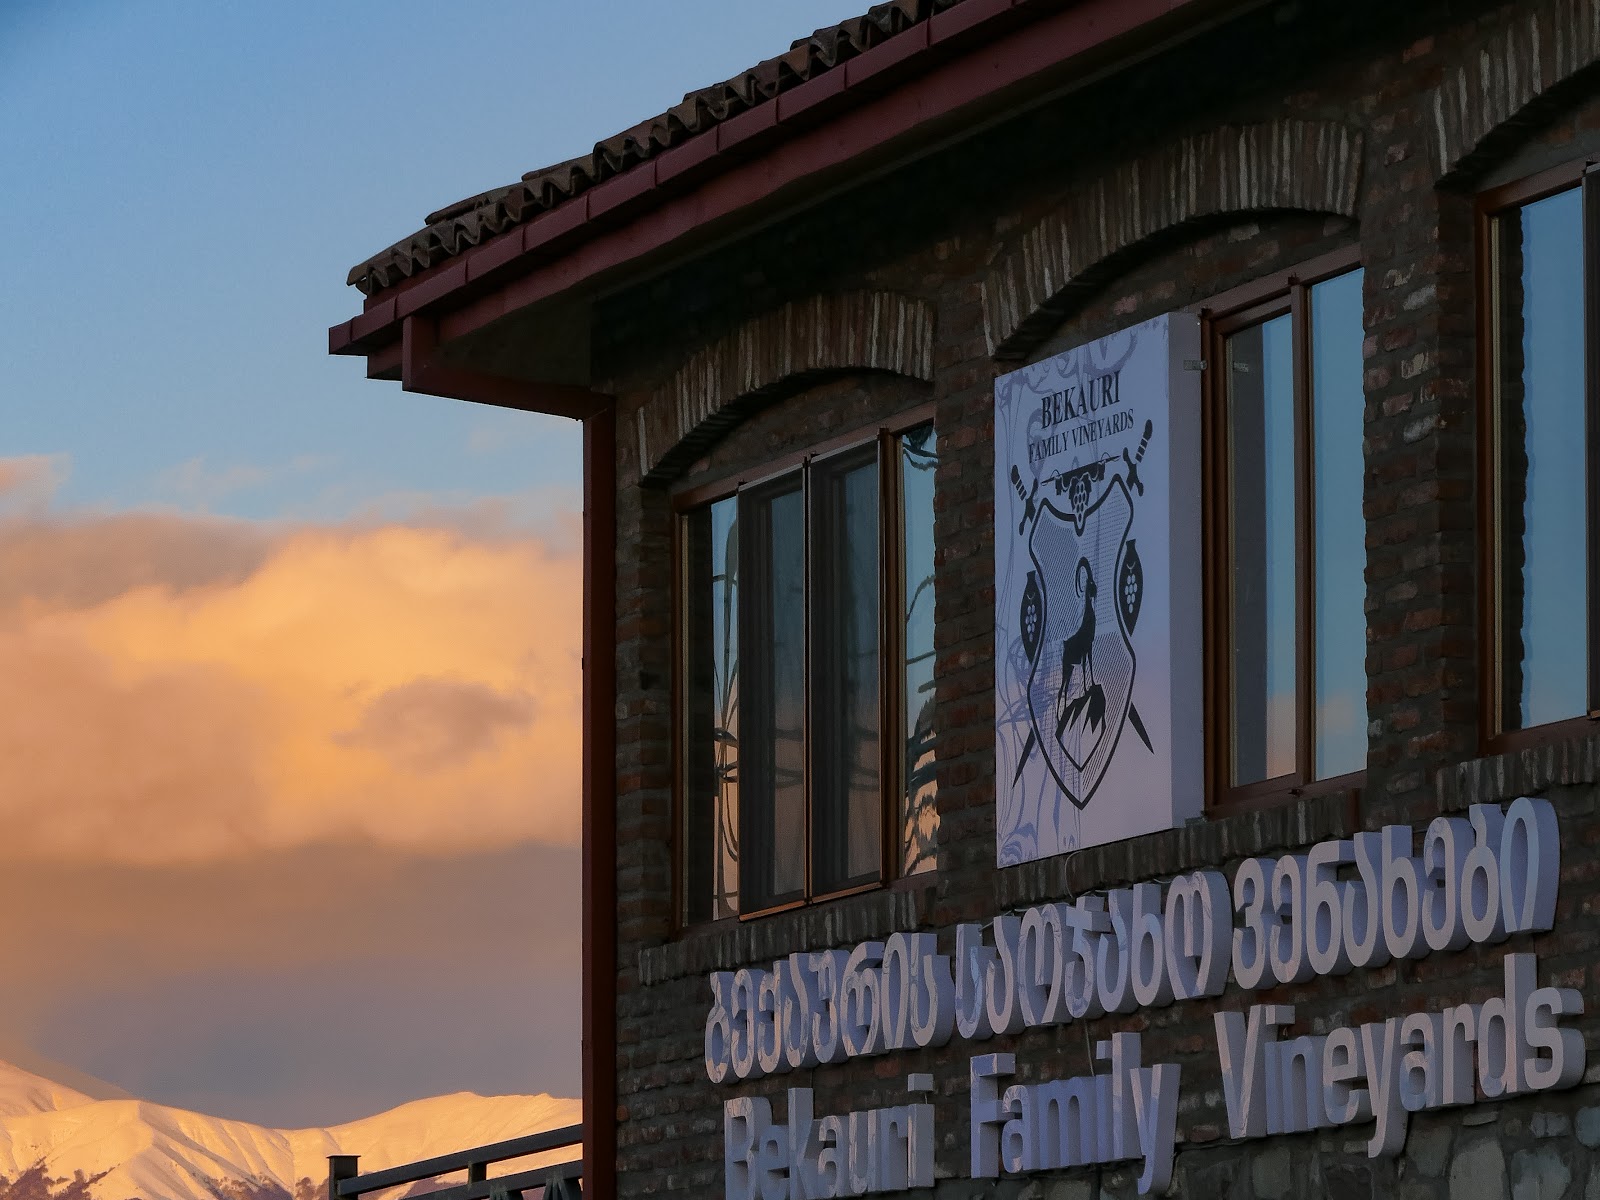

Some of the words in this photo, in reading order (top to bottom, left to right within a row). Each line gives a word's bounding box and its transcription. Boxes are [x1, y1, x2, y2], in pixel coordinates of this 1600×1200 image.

[1028, 430, 1069, 464] FAMILY
[1071, 408, 1135, 447] VINEYARDS
[1041, 370, 1121, 430] BEKAURI
[705, 931, 954, 1084] ბექაურის
[955, 870, 1232, 1039] საოჯახო
[1232, 797, 1561, 990] ვენახები
[970, 1032, 1181, 1195] Family
[1214, 953, 1586, 1158] Vineyards
